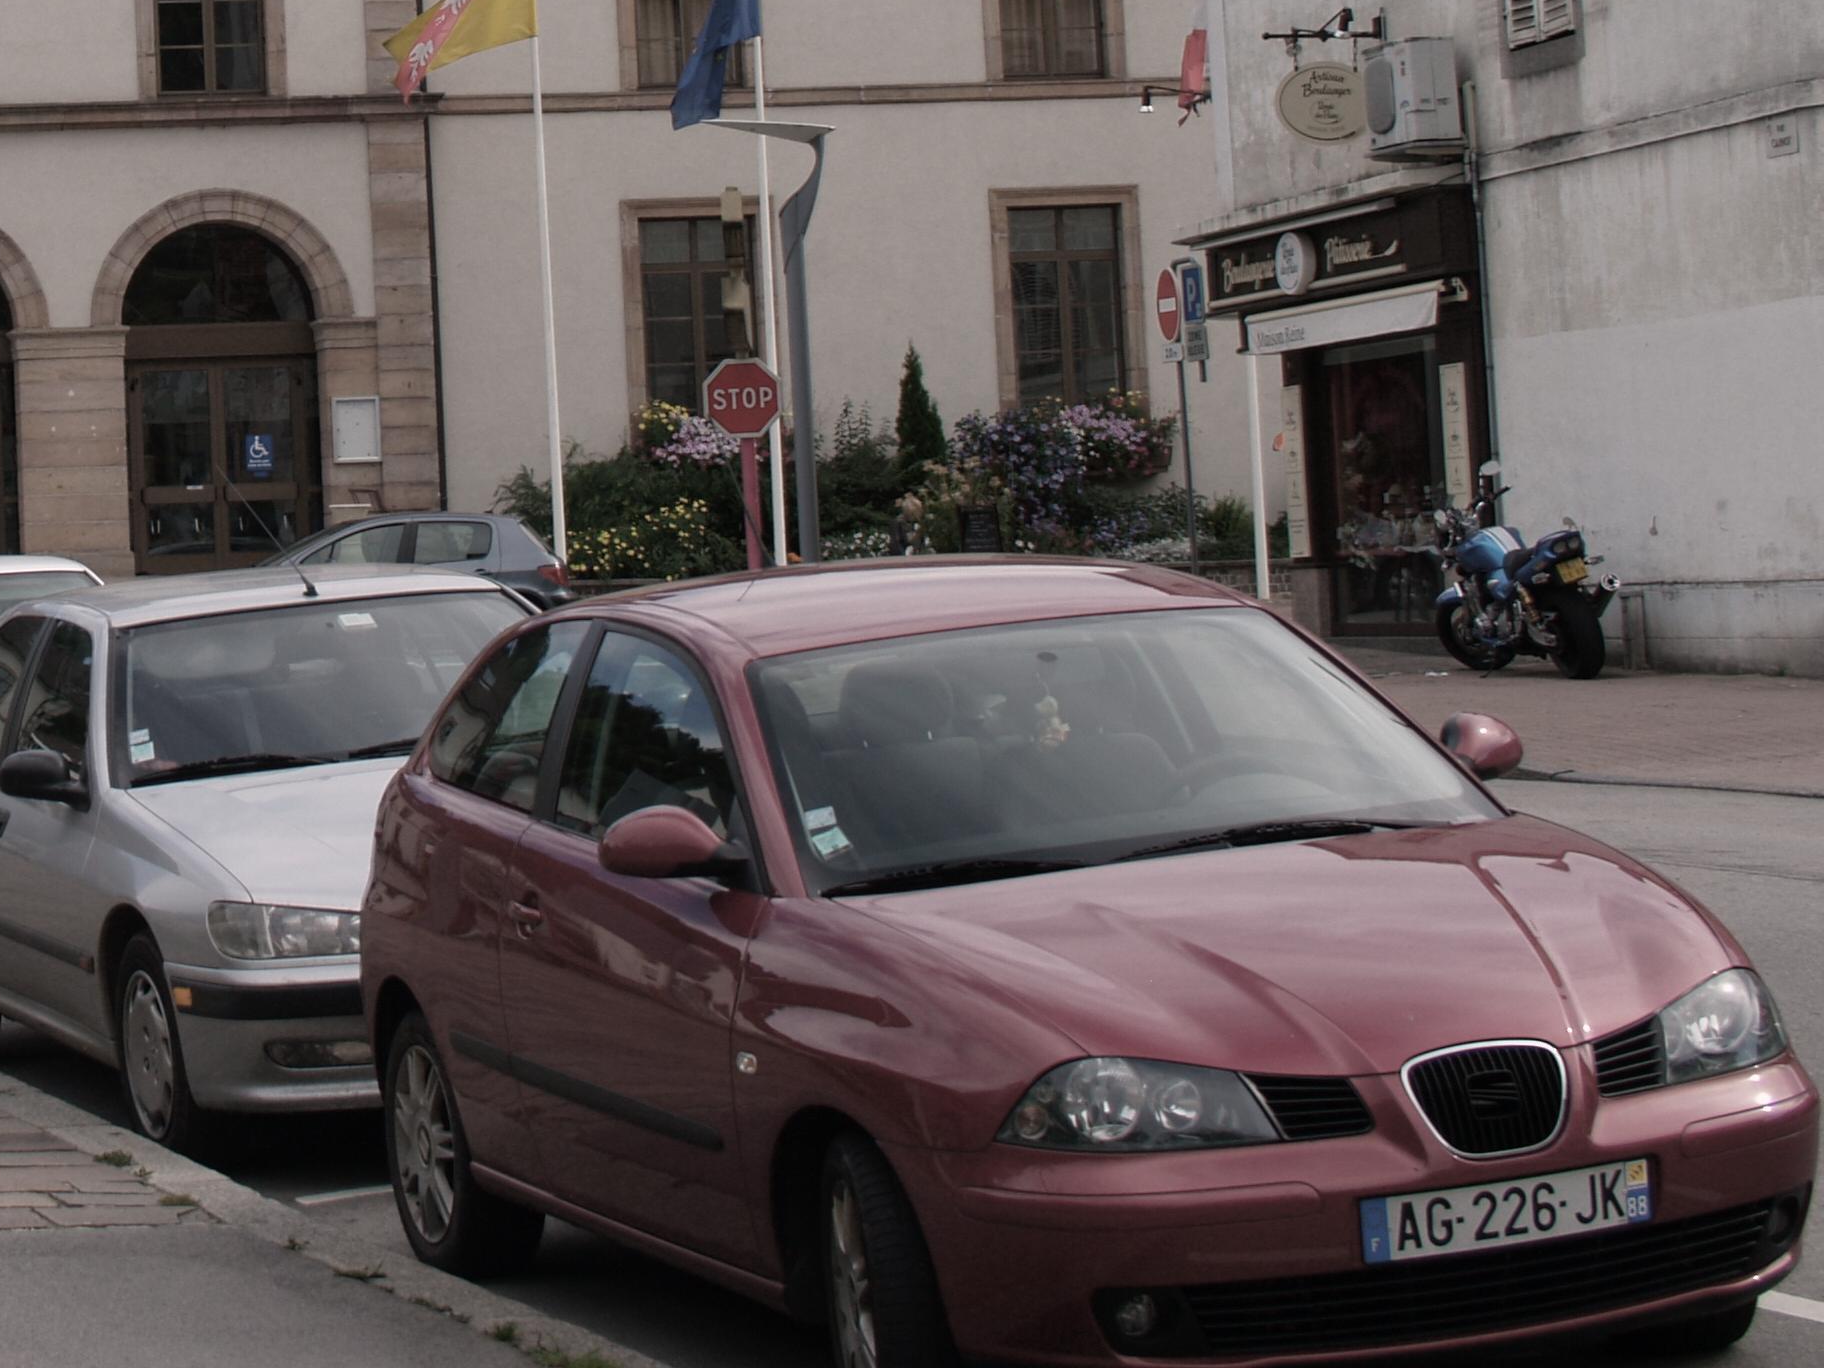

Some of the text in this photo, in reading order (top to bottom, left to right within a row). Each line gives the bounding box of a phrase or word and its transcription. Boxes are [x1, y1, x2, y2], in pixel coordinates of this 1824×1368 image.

[1301, 83, 1352, 98] Boulanger
[713, 387, 773, 410] STOP
[1397, 1168, 1625, 1251] AG-226-JK
[1627, 1195, 1648, 1217] 88
[1370, 1237, 1380, 1252] F
